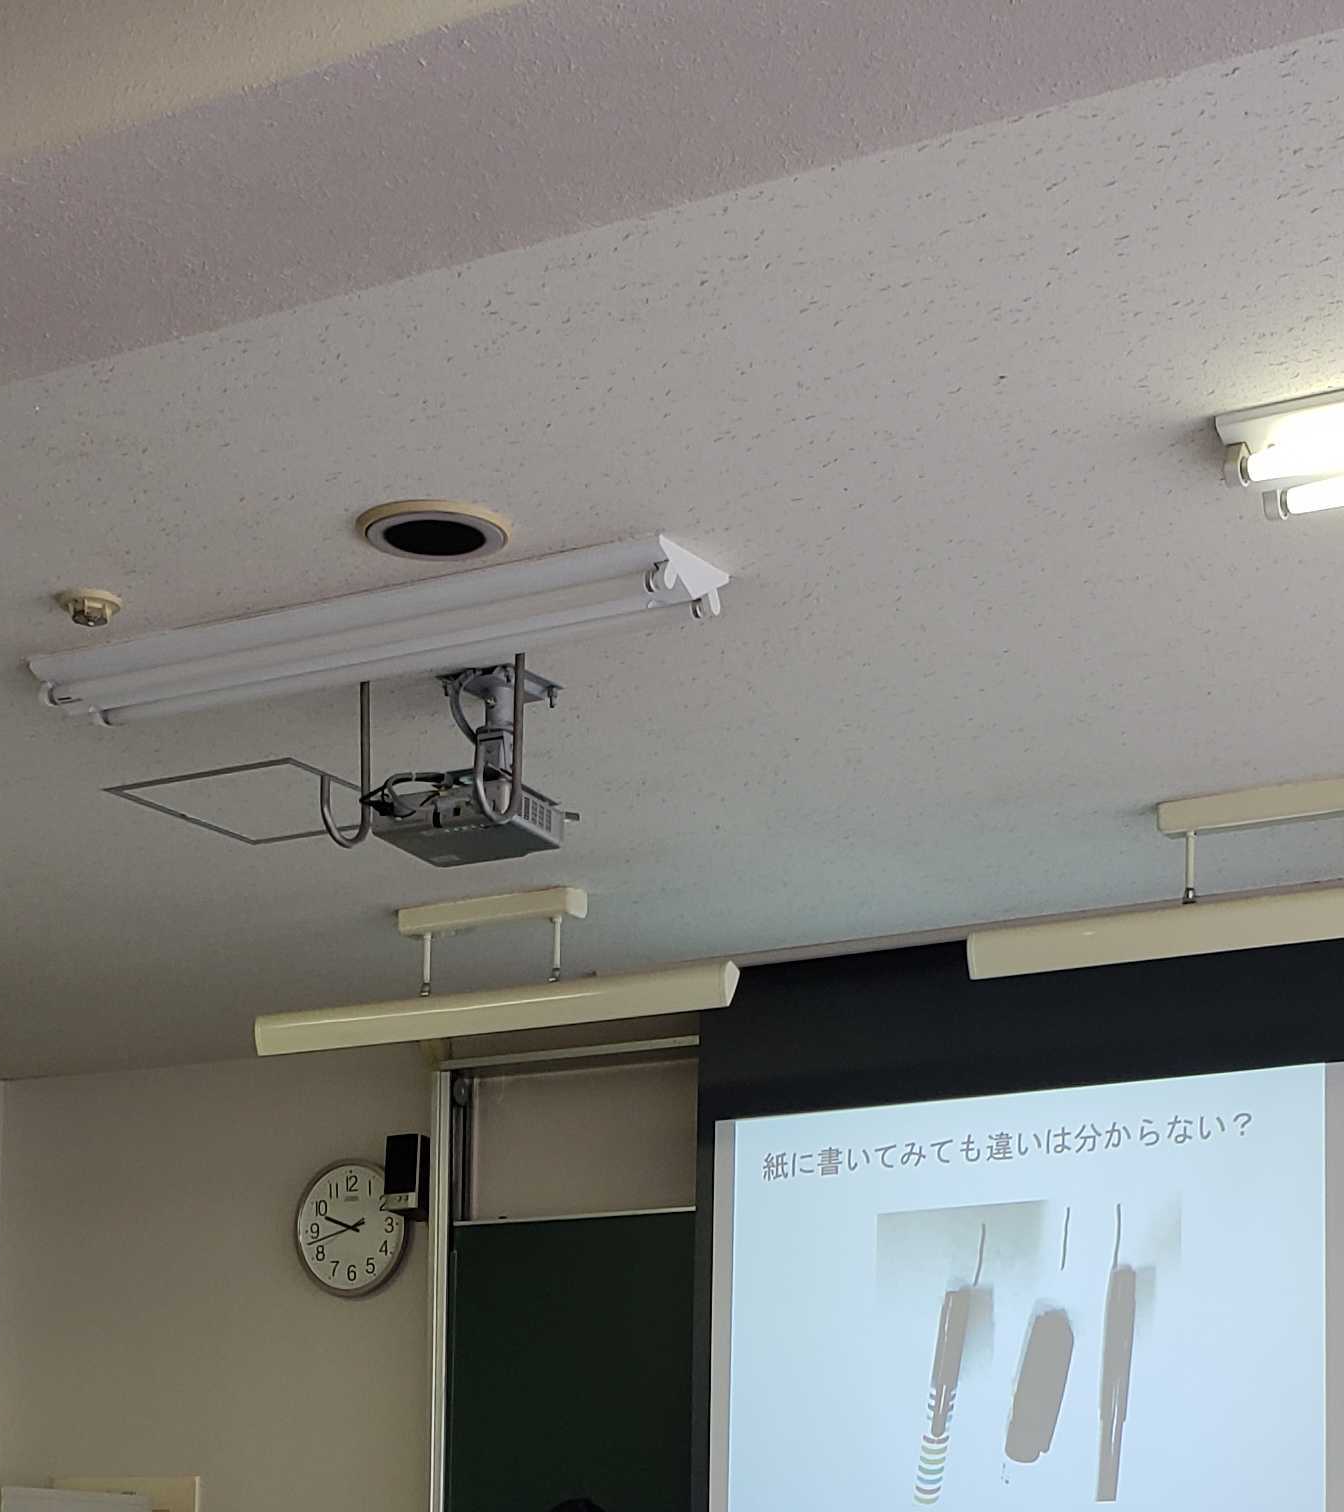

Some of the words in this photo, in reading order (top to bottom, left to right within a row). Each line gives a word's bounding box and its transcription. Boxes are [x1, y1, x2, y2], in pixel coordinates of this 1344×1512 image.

[762, 1112, 1253, 1182] 紙に書いてみても違いは分からない？
[346, 1175, 359, 1192] 12
[315, 1199, 328, 1217] 10
[310, 1222, 320, 1239] 9
[384, 1217, 394, 1233] 3
[315, 1245, 325, 1261] 8
[379, 1240, 389, 1256] 4
[330, 1260, 340, 1277] 7
[347, 1264, 357, 1281] 6
[365, 1258, 376, 1274] 5
